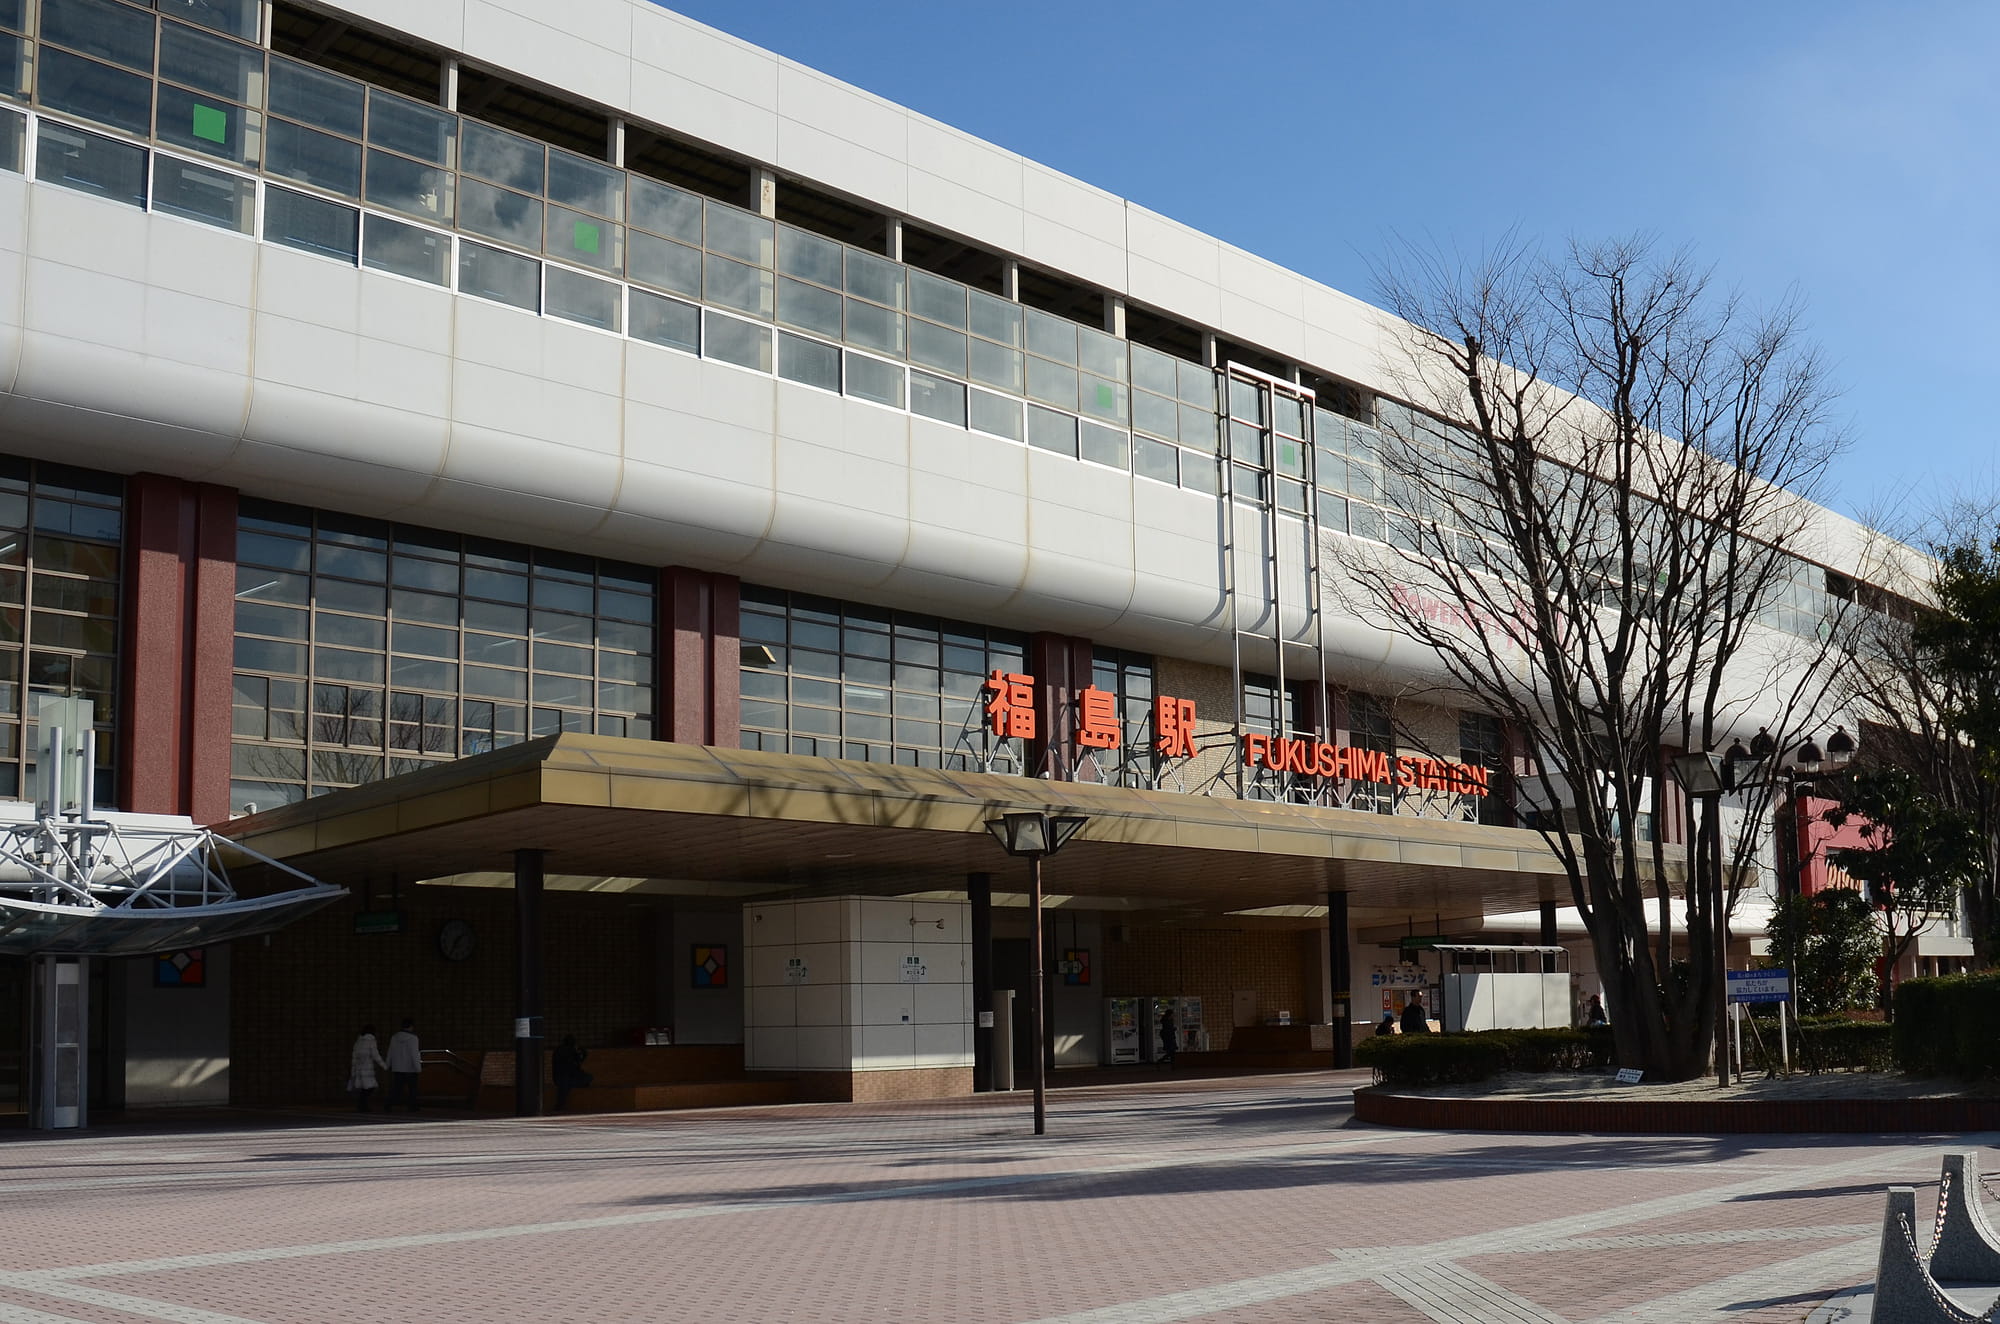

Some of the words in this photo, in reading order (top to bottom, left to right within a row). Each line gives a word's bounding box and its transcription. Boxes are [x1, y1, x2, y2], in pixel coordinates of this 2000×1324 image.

[985, 669, 1198, 758] 福島駅
[1245, 733, 1391, 785] FUKUSHIMA
[1396, 755, 1488, 797] STATION
